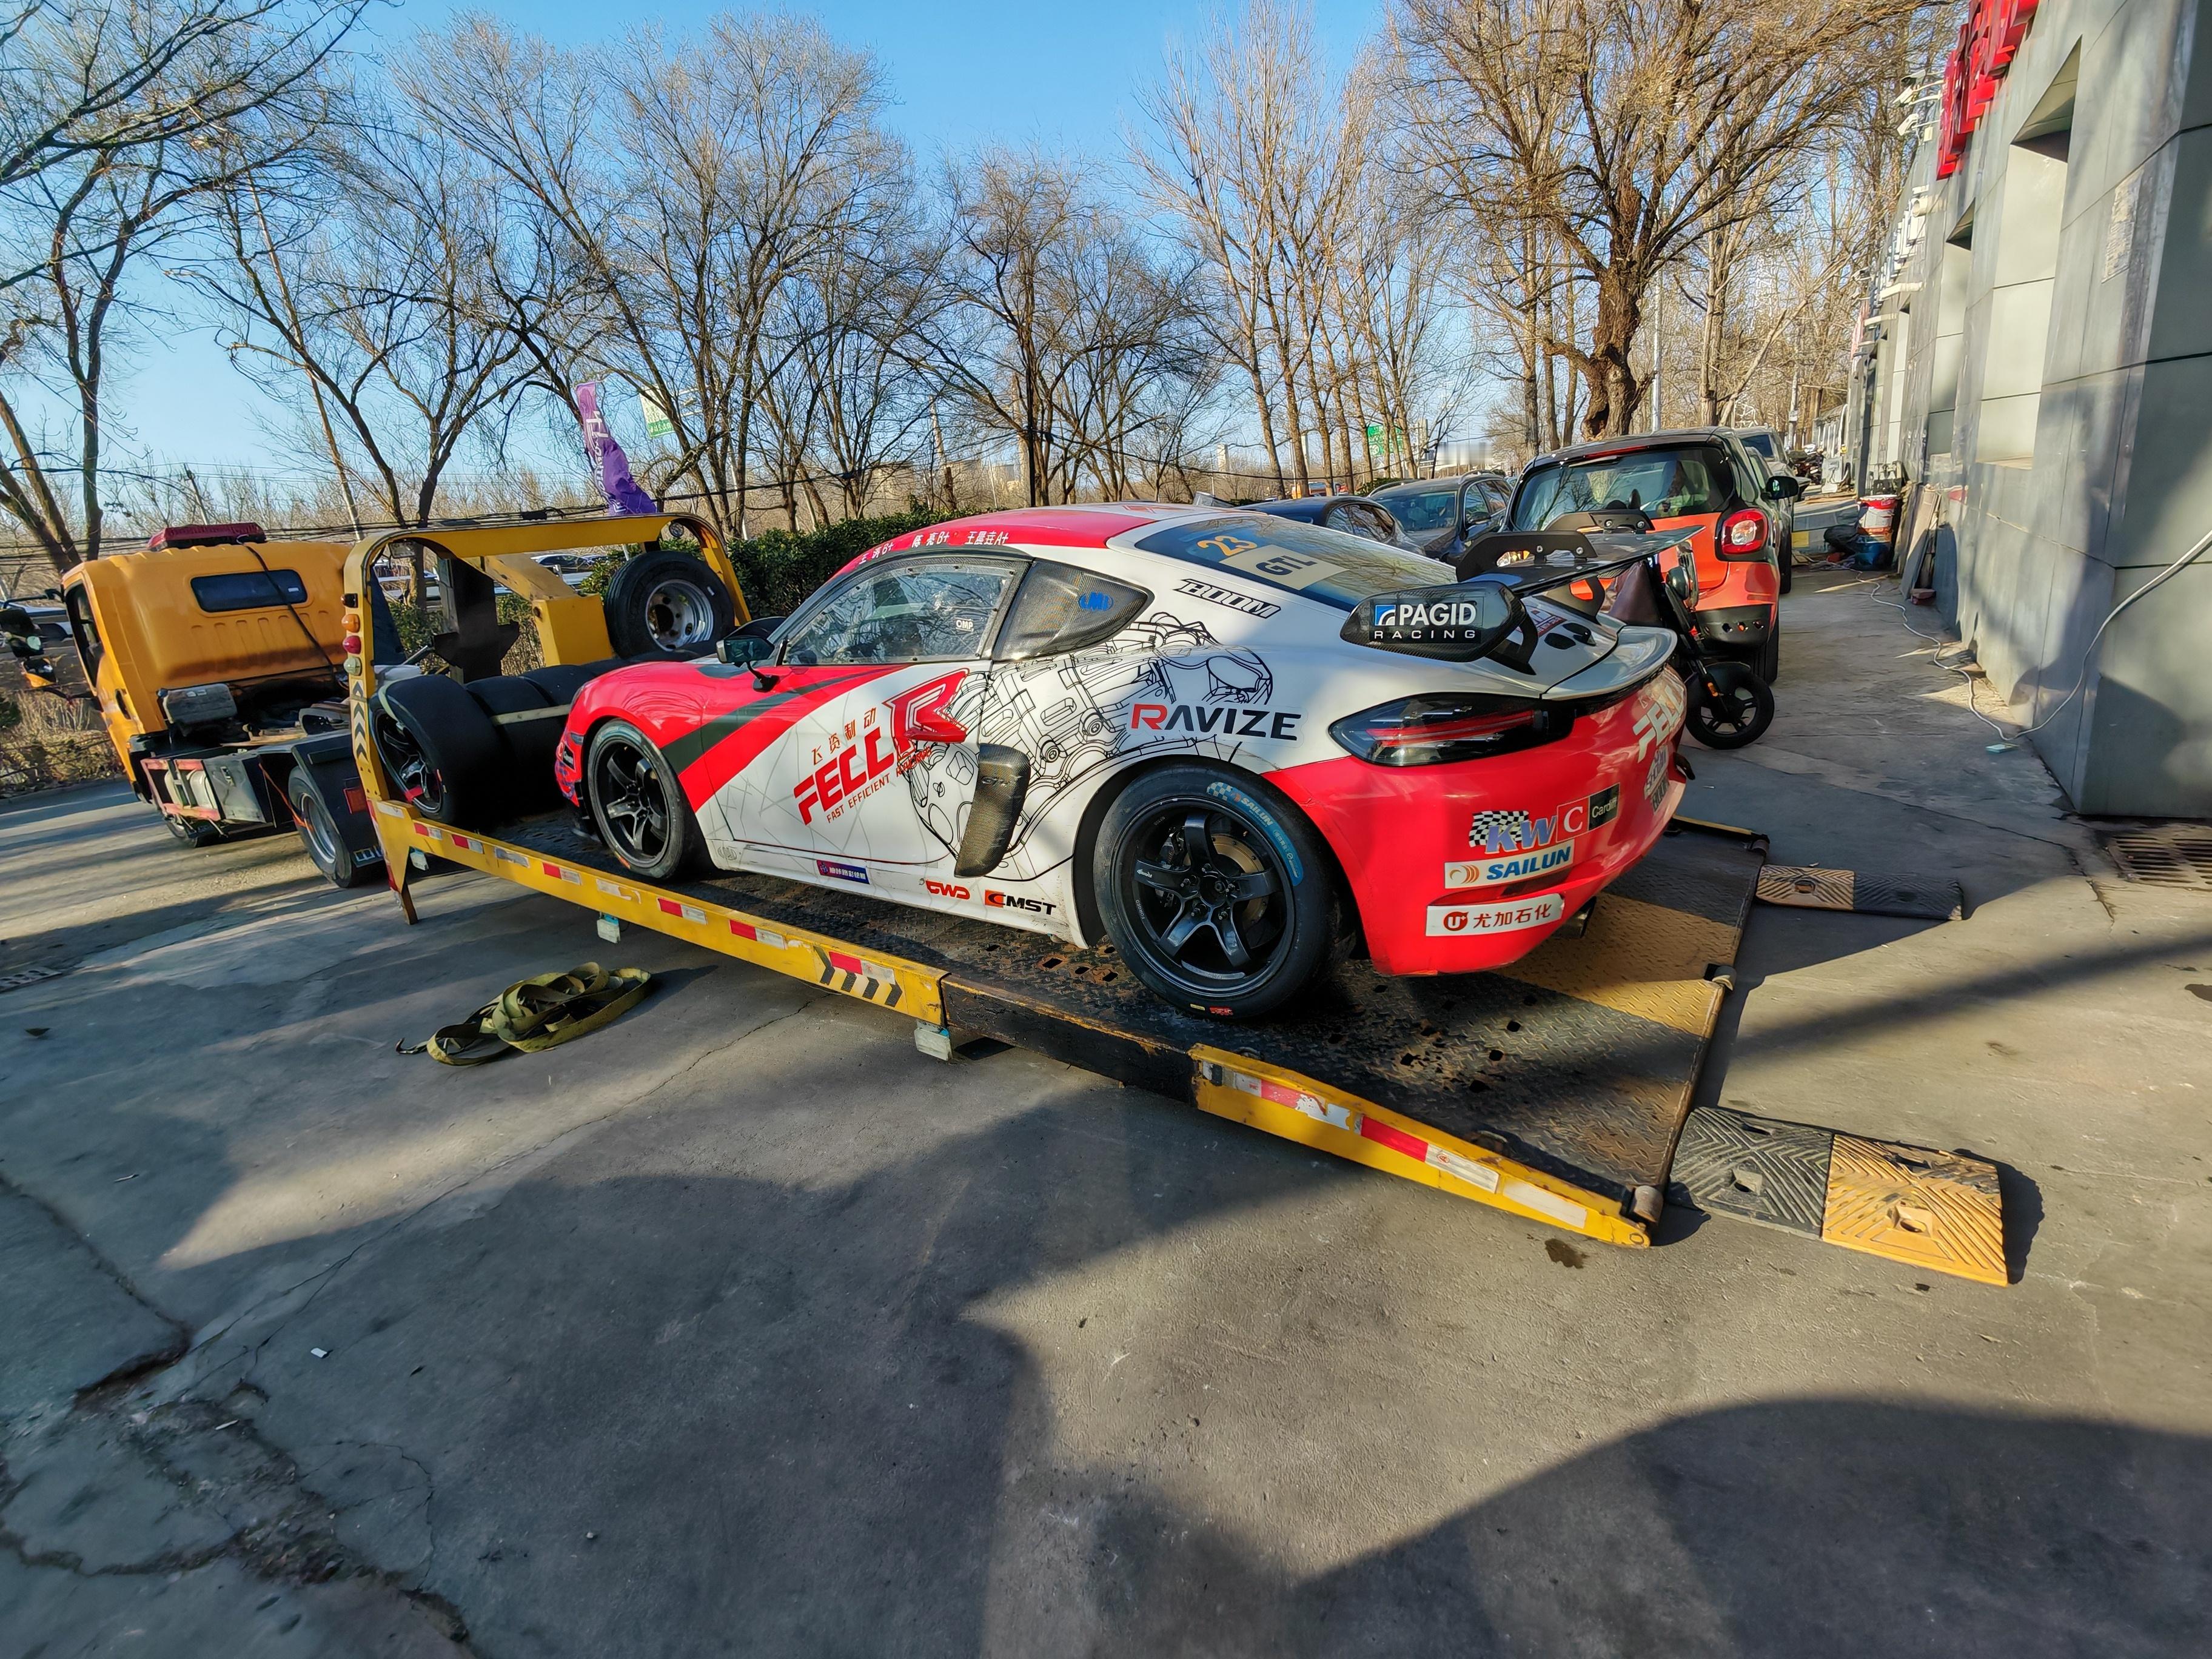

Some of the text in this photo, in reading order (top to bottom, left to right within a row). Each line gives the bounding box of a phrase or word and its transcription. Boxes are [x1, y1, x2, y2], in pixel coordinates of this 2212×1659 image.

[1197, 535, 1258, 557] 23
[1256, 555, 1318, 575] GTL
[1173, 578, 1281, 619] BOOM
[956, 619, 973, 630] OMP
[1399, 603, 1476, 626] PAGID
[1374, 629, 1475, 639] RACING
[1131, 703, 1302, 741] RAVIZE
[826, 804, 845, 823] FAST
[848, 773, 890, 809] EFFICIENT
[1241, 797, 1273, 826] SAILUN
[1563, 806, 1584, 833] C
[1485, 816, 1557, 854] KW
[1486, 846, 1571, 880] SAILUN
[988, 892, 1056, 915] CMST
[1135, 899, 1145, 920] FORGED
[1473, 903, 1552, 929] 尤加石化
